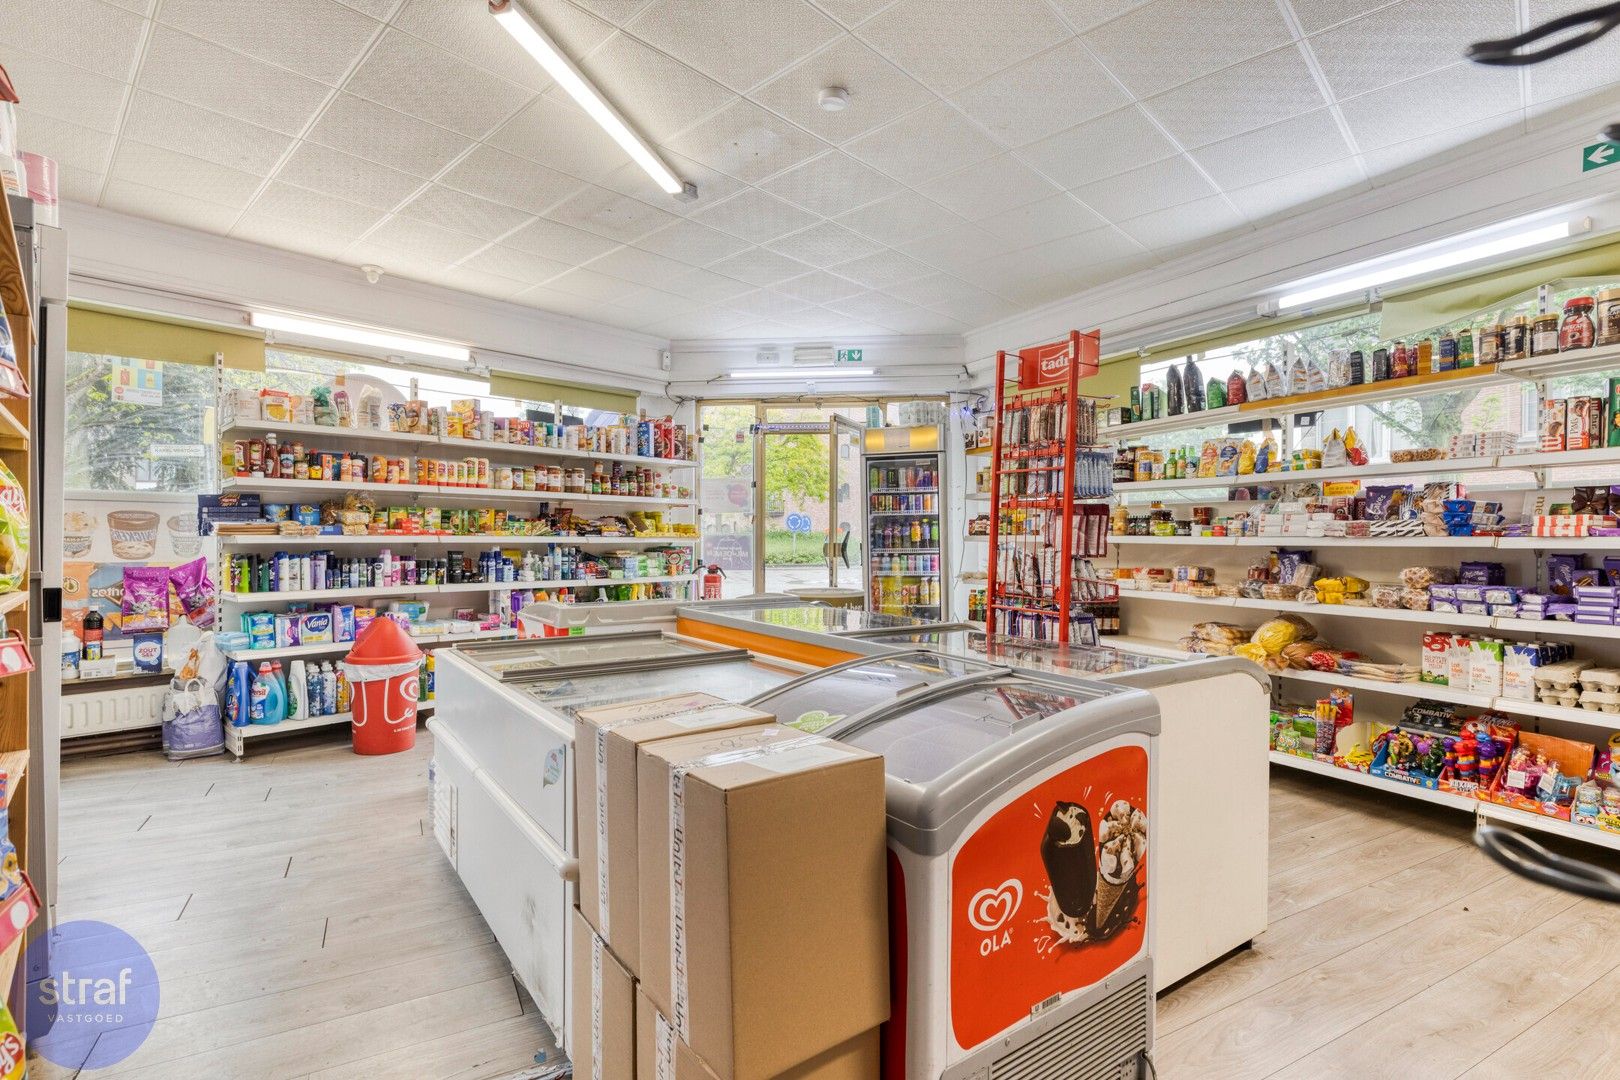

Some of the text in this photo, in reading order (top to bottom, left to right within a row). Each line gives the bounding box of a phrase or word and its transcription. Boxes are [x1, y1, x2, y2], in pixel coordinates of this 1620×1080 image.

[1535, 496, 1545, 515] me
[306, 616, 328, 628] Vania
[1411, 707, 1455, 719] COMBATIV
[980, 931, 1012, 955] OLA
